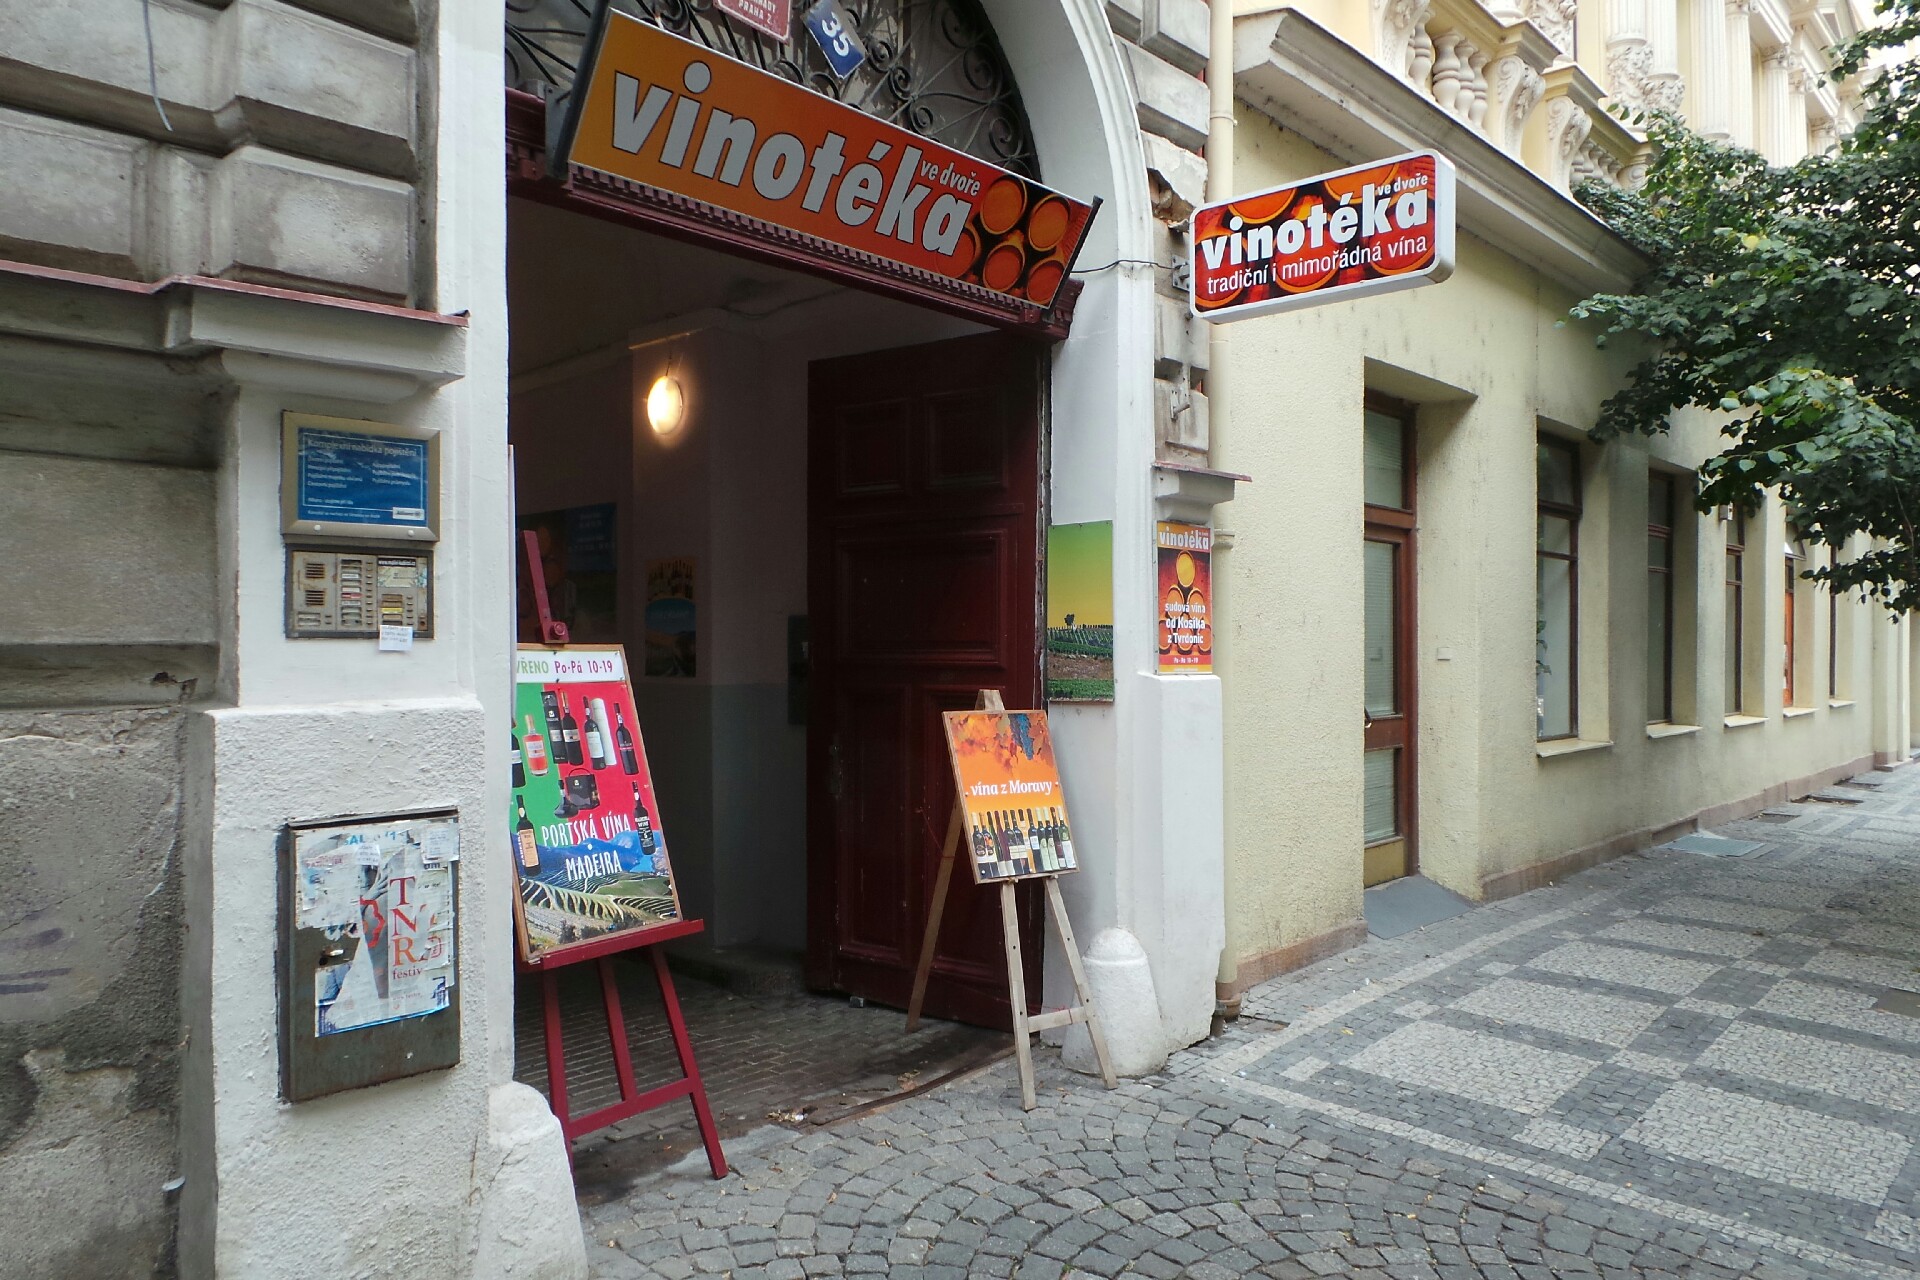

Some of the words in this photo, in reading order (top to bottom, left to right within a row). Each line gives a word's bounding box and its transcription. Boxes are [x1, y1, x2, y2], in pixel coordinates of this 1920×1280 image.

[738, 0, 764, 20] PRAHA
[821, 11, 854, 57] 35
[612, 60, 973, 258] vinotéka
[920, 160, 938, 180] ve
[939, 162, 981, 196] dvoře
[1376, 185, 1391, 196] ve
[1394, 173, 1428, 192] dvoře
[1201, 182, 1429, 270] vinotéka
[1207, 264, 1268, 295] tradiční
[1272, 266, 1277, 281] i
[1282, 240, 1382, 280] mimořádná
[1387, 235, 1427, 259] vína
[1159, 525, 1209, 550] vinotéka
[1165, 601, 1190, 613] sudová
[1191, 602, 1206, 614] vína
[1165, 617, 1176, 629] od
[1167, 634, 1173, 643] z
[554, 660, 582, 674] Po-Pá
[587, 660, 613, 674] 10-19
[970, 781, 999, 796] vína
[1001, 785, 1008, 795] z
[1009, 780, 1052, 796] Moravy
[541, 813, 599, 848] PORTSKÁ
[601, 811, 632, 839] VÍNA
[565, 850, 623, 881] MADEIRA
